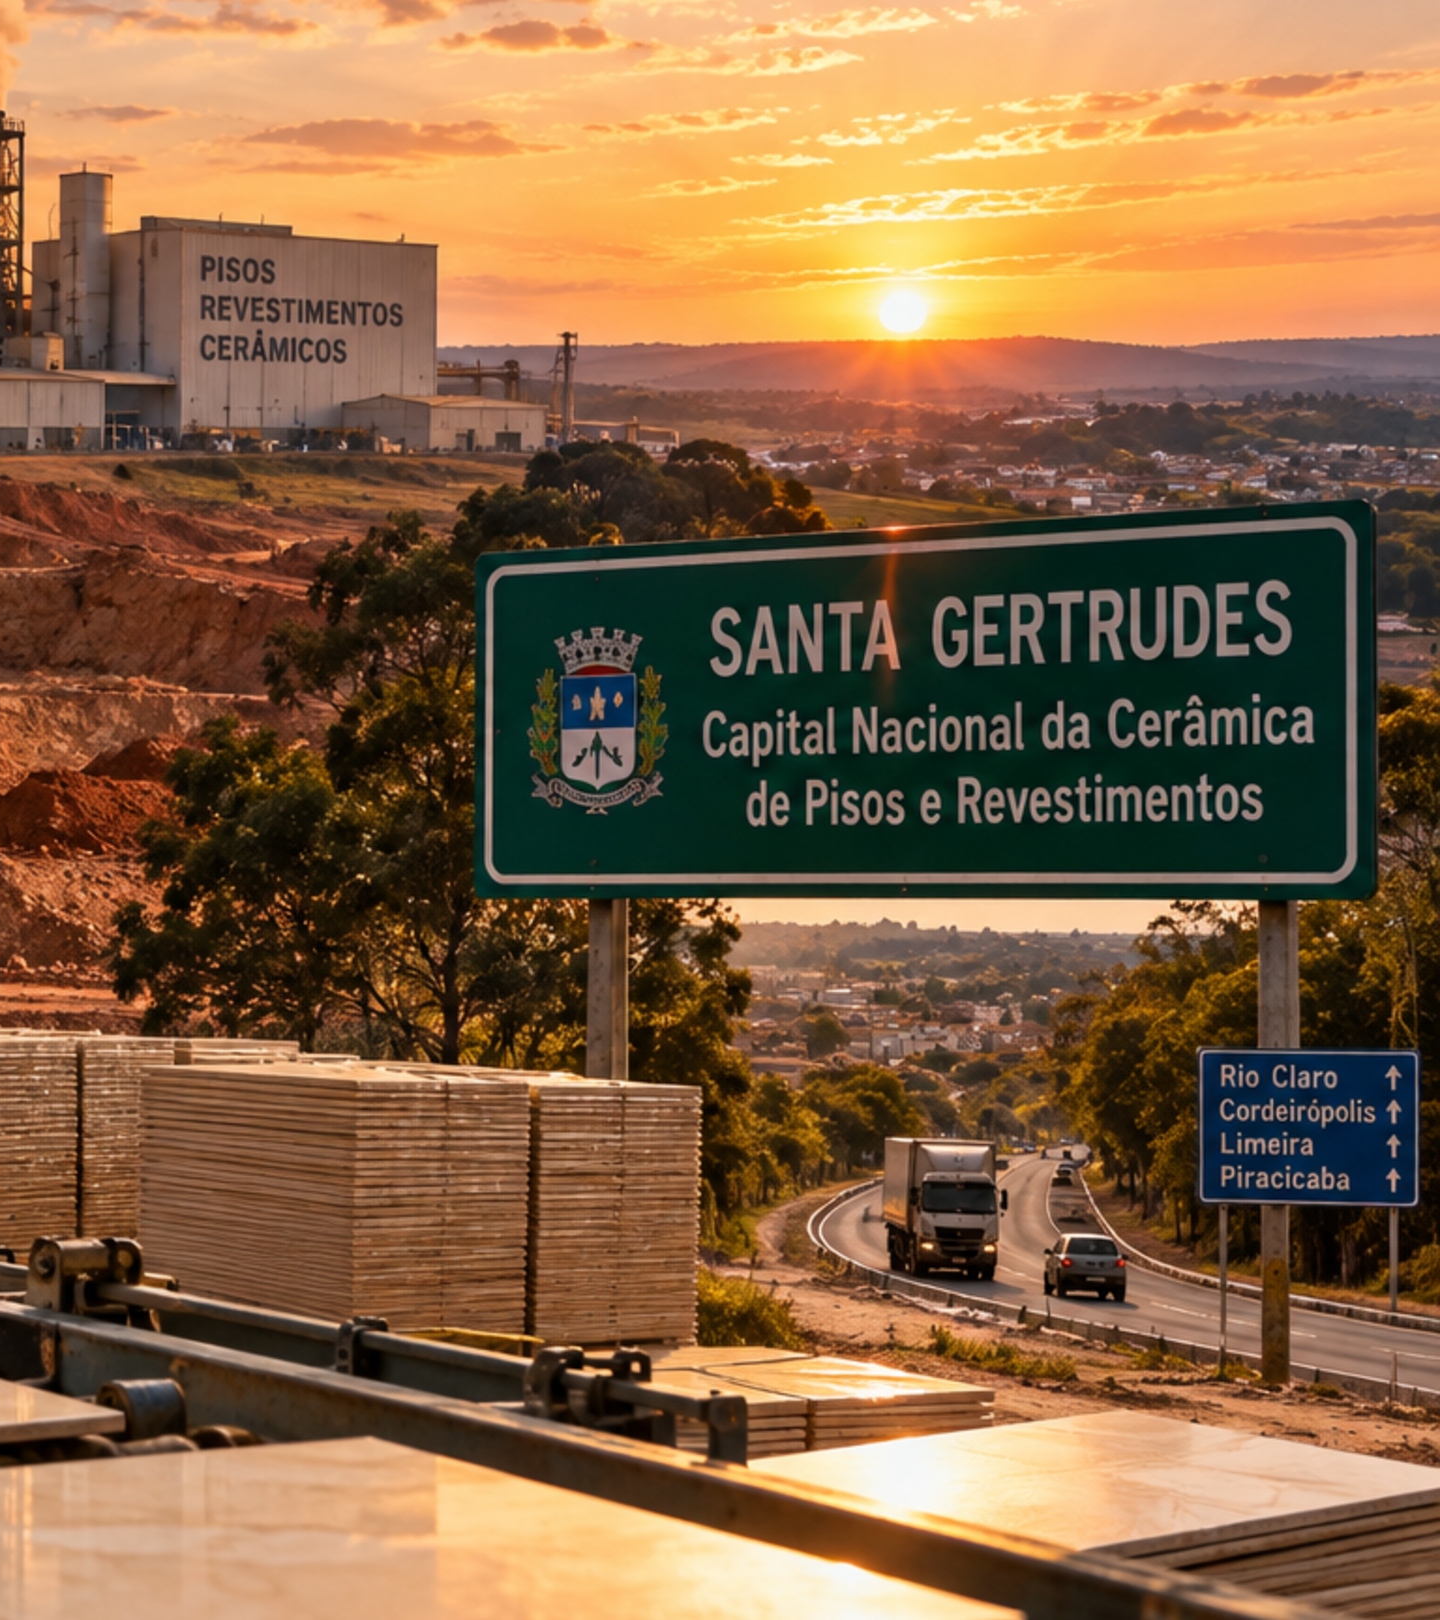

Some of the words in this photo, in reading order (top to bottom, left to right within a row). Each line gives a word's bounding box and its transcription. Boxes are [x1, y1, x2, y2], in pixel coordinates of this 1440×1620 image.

[200, 255, 276, 285] PISOS
[200, 294, 404, 327] REVESTIMENTOS
[709, 600, 901, 678] SANTA
[931, 579, 1293, 669] GERTRUDES
[702, 706, 837, 768] Capital
[852, 702, 1025, 755] Nacional
[1041, 700, 1091, 751] da
[1107, 695, 1315, 750] Cerâmica
[746, 779, 790, 828] de
[805, 778, 905, 827] Pisos
[920, 789, 942, 826] e
[957, 773, 1264, 825] Revestimentos
[1220, 1063, 1260, 1088] Rio
[1272, 1063, 1338, 1089] Claro
[1219, 1098, 1377, 1129] Cordeirópolis
[1220, 1131, 1314, 1156] Limeira
[1220, 1164, 1350, 1191] Piracicaba
